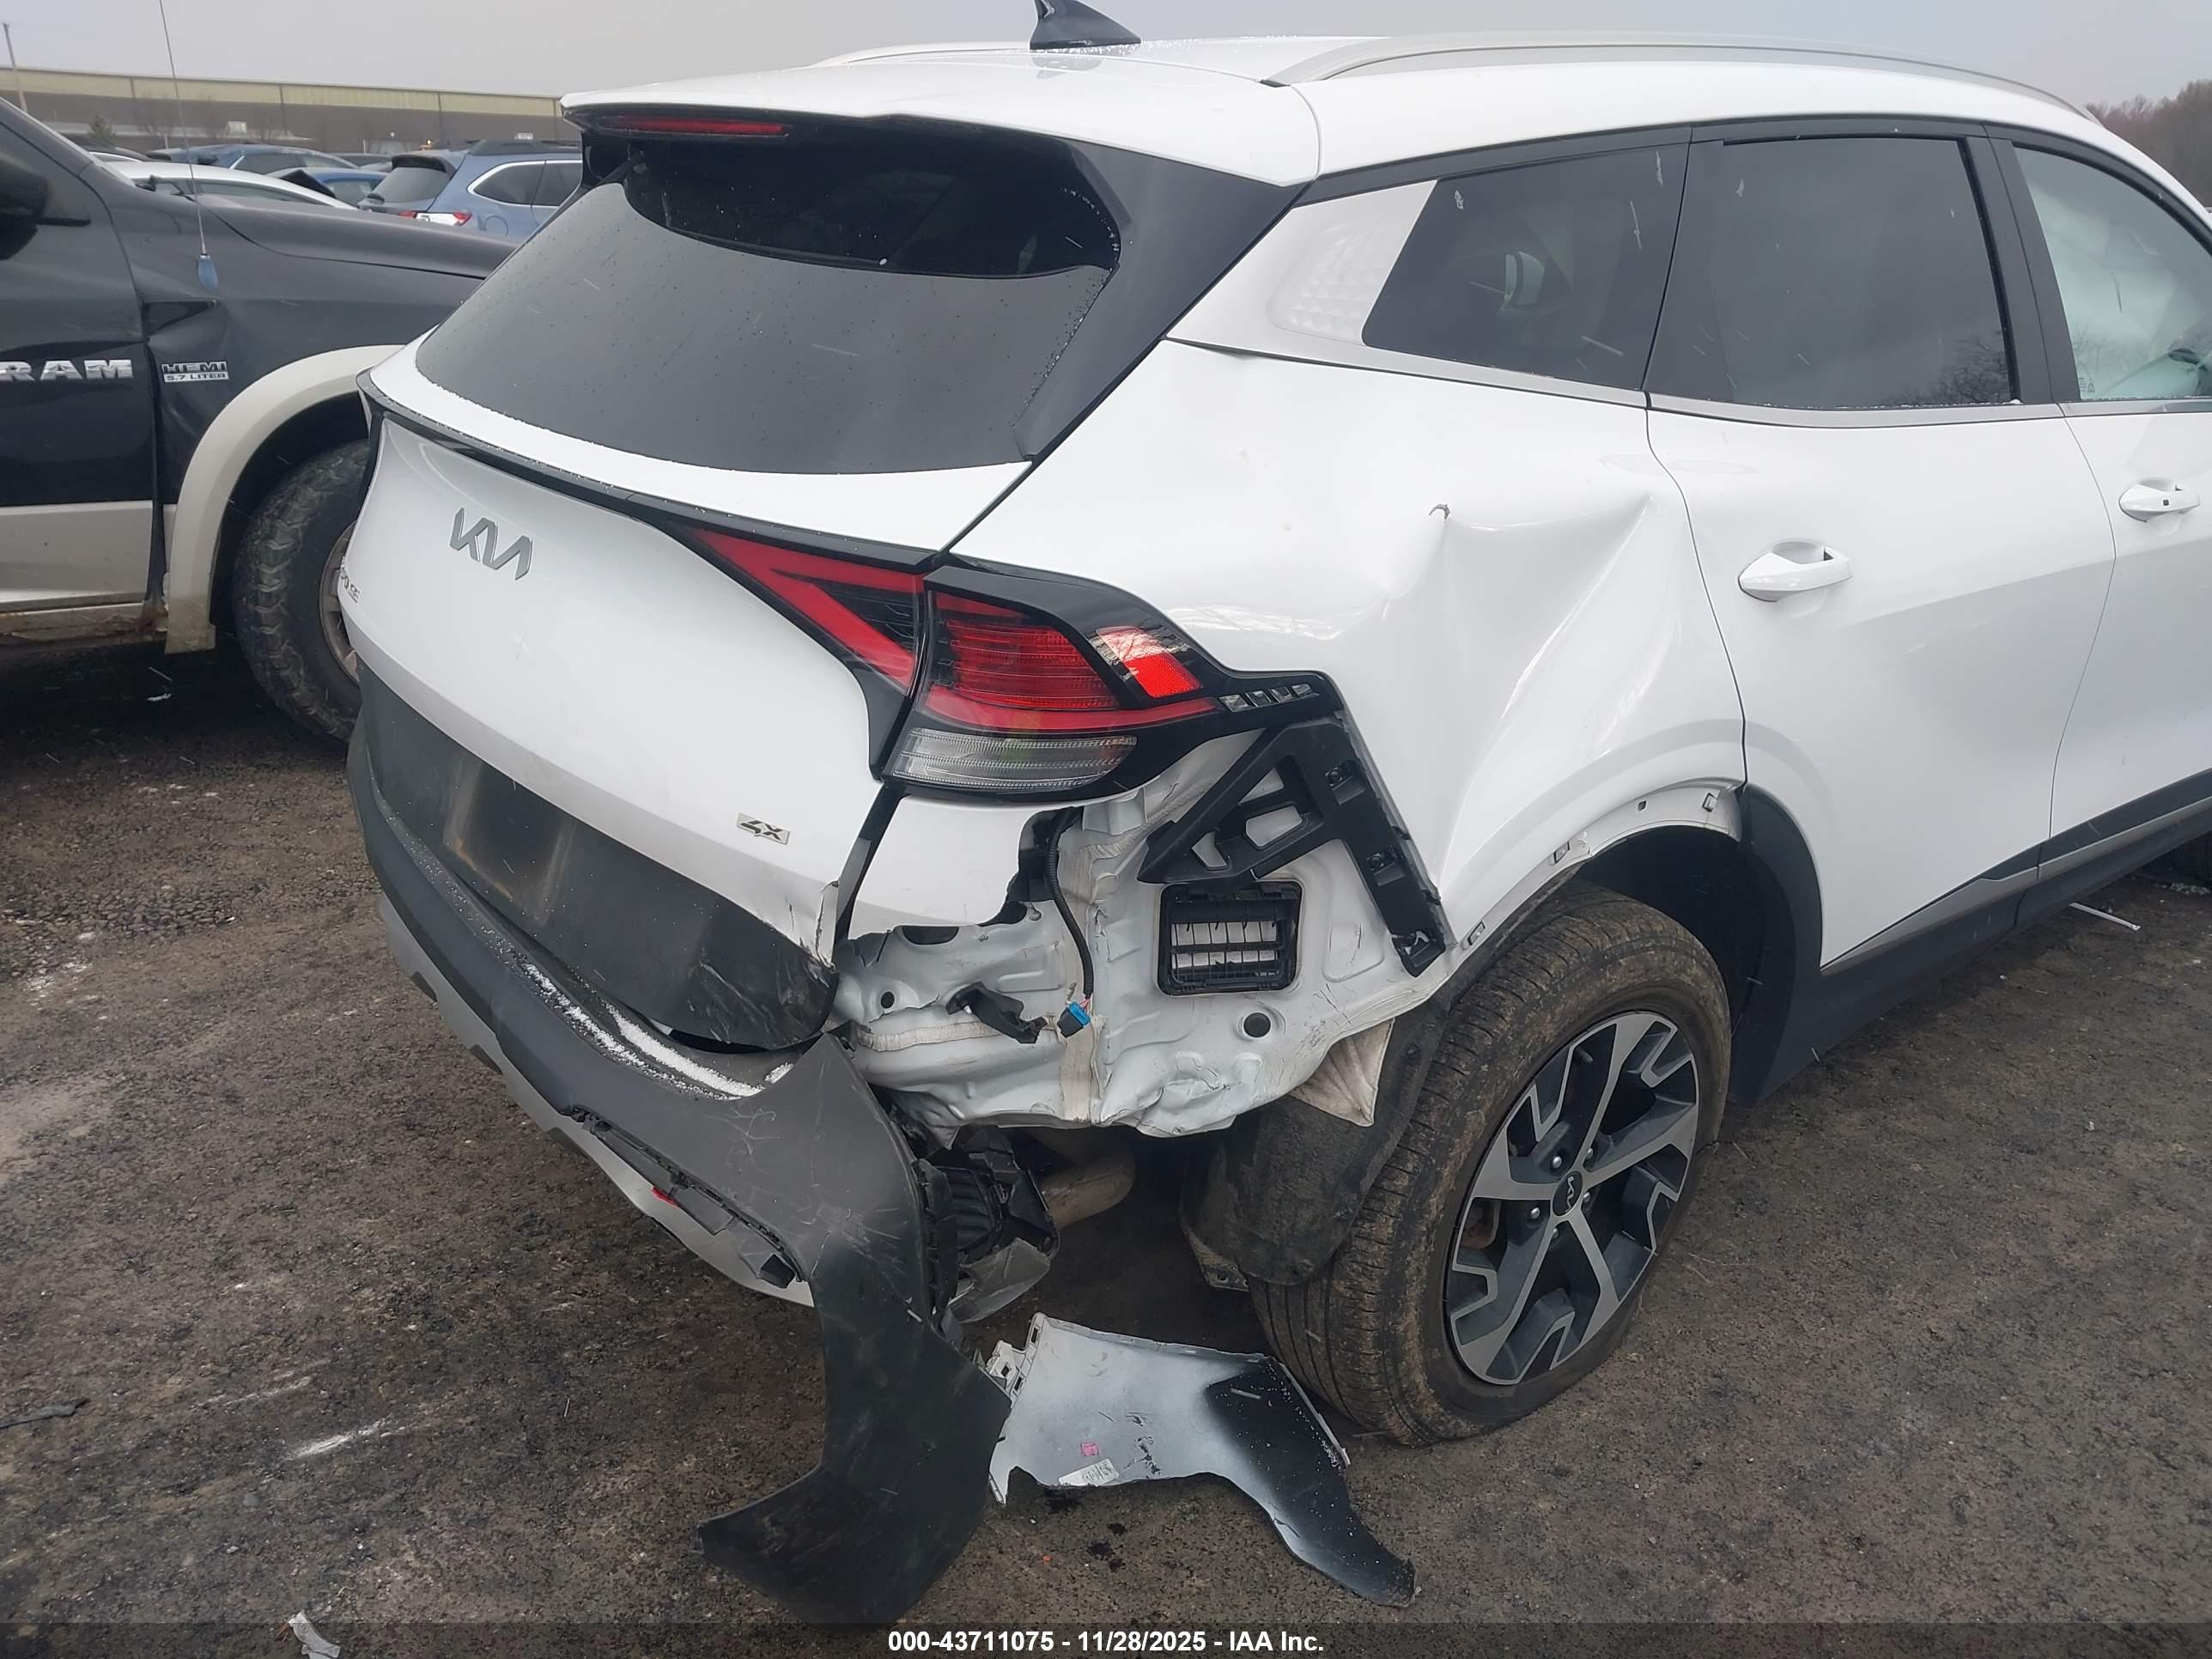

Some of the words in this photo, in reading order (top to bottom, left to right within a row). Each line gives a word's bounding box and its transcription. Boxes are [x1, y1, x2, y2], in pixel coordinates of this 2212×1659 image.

[0, 359, 133, 381] RAM
[161, 362, 227, 374] HEMI
[450, 507, 533, 580] KIA
